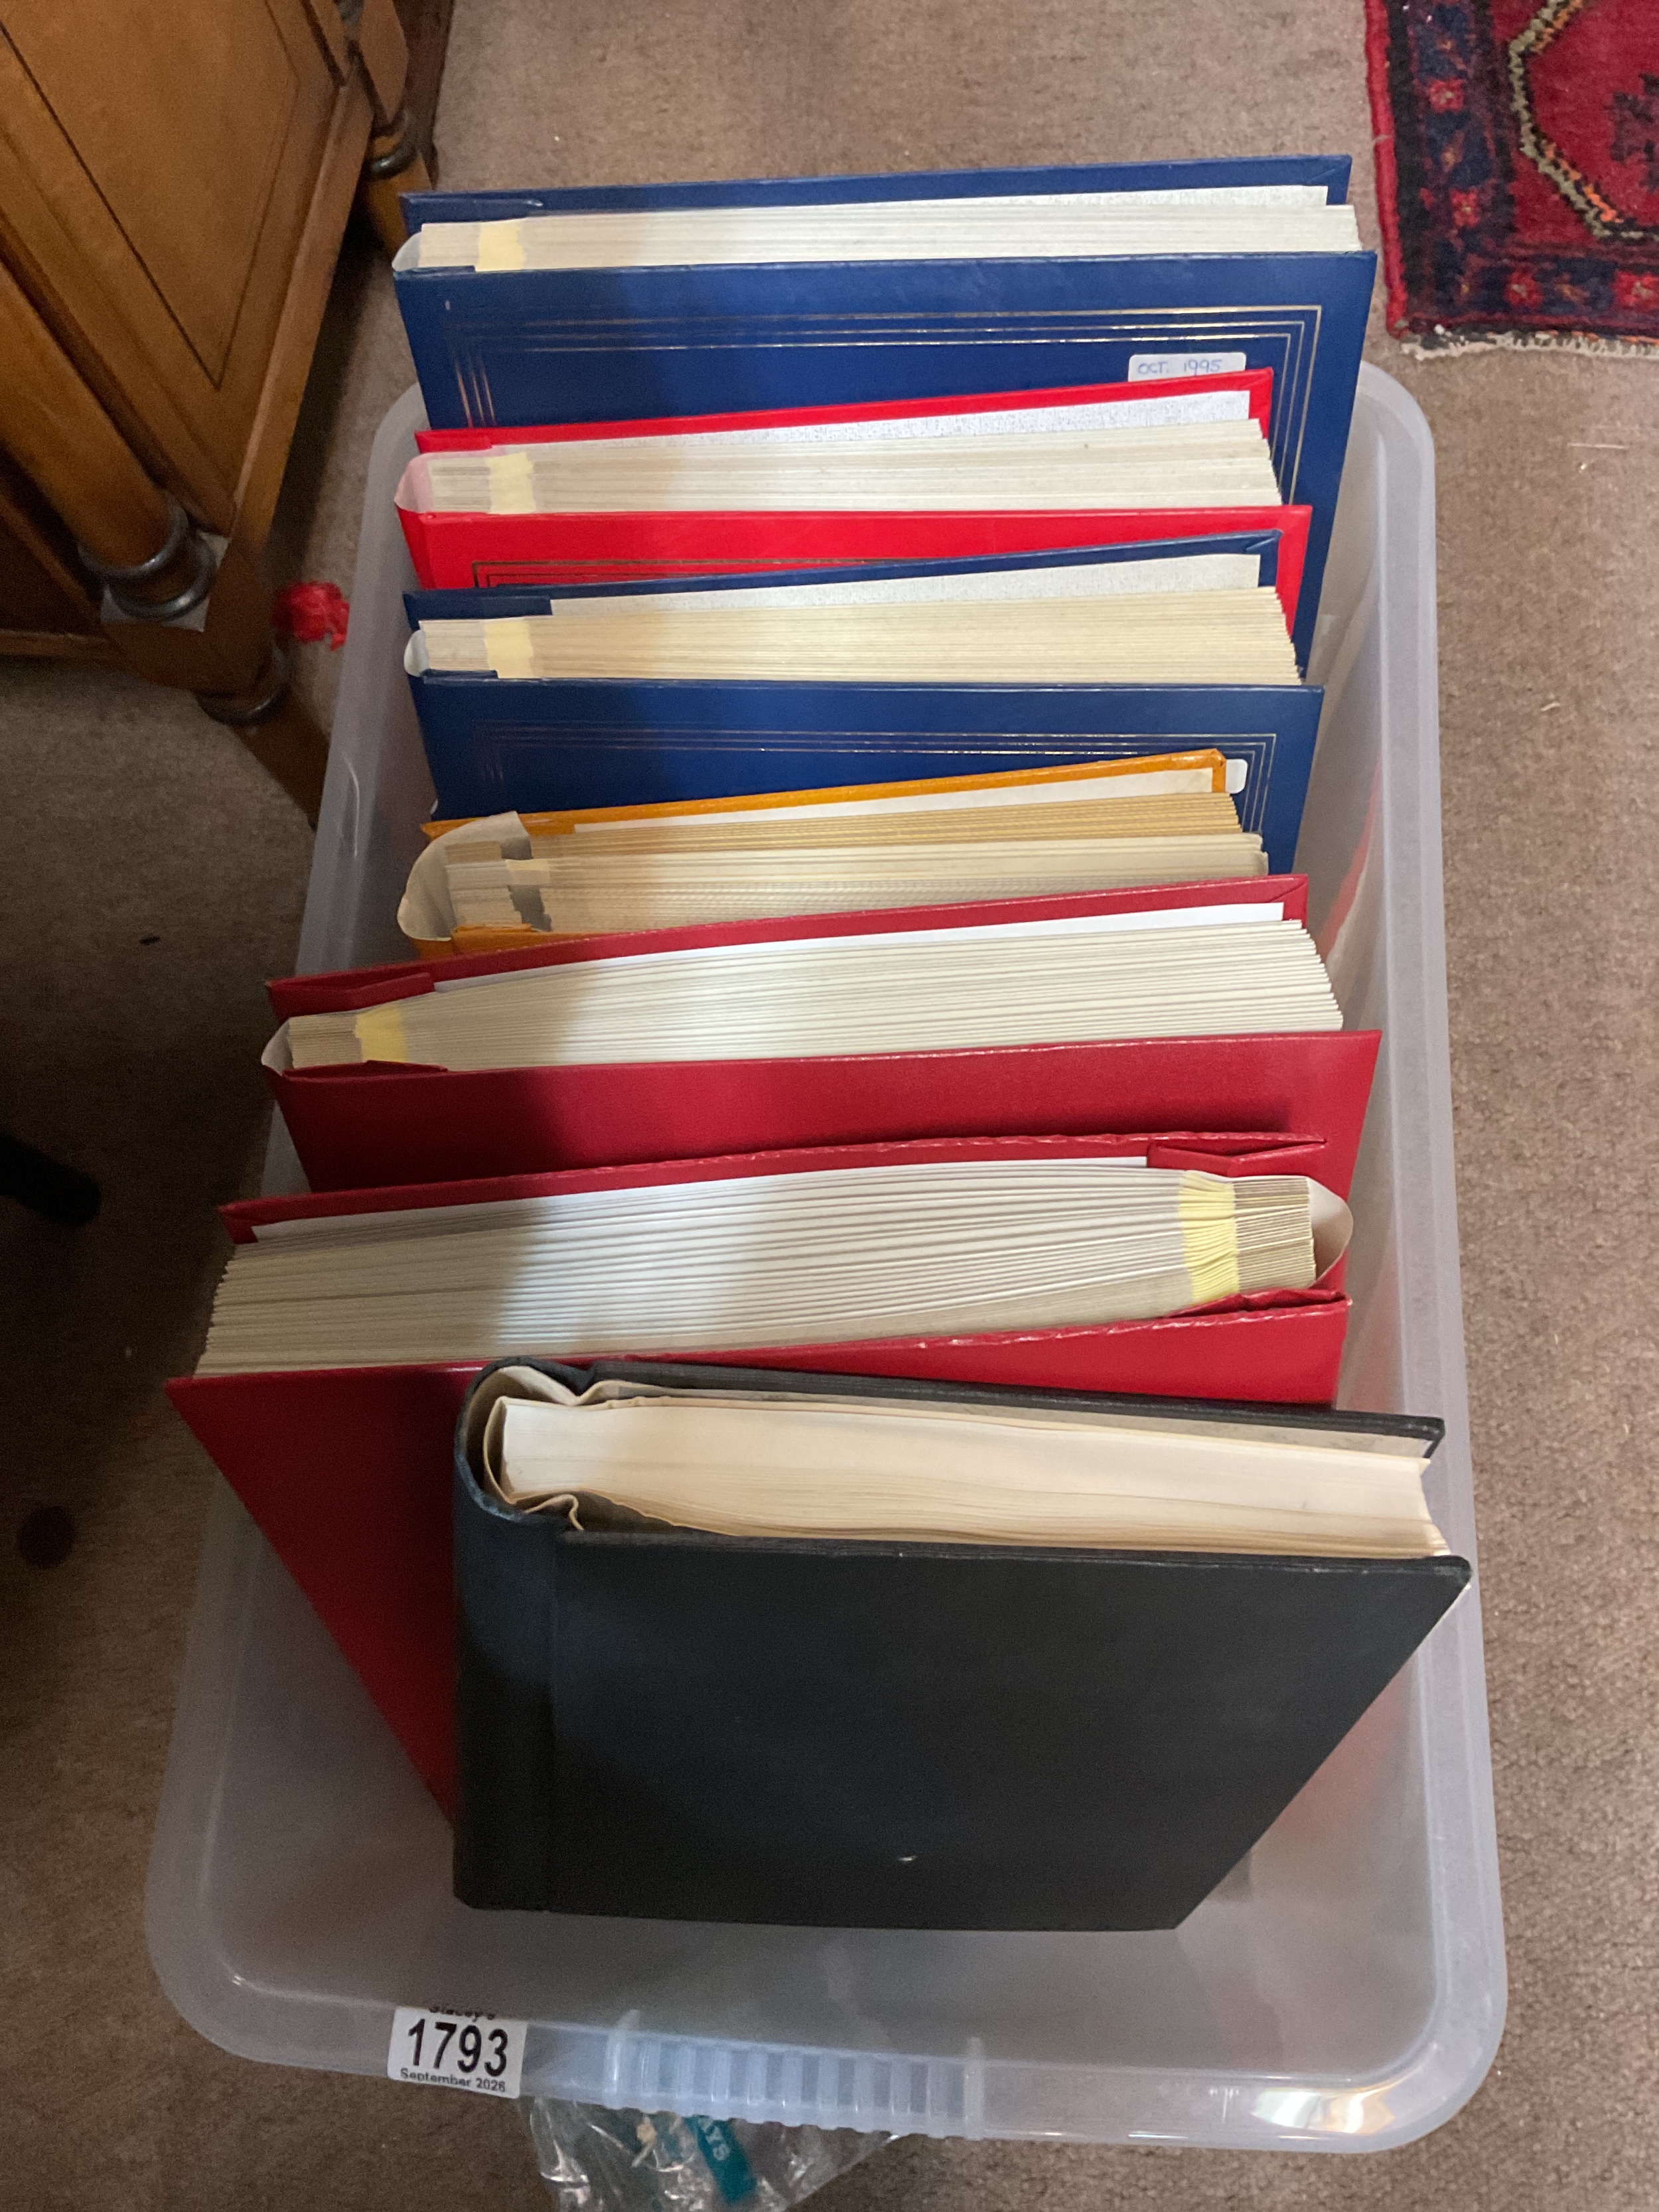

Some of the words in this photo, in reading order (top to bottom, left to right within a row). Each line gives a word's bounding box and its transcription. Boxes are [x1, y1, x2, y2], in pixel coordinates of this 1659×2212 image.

[1137, 361, 1169, 374] OCT.
[1184, 359, 1222, 376] 1995
[408, 2018, 508, 2077] 1793
[400, 2067, 471, 2087] September
